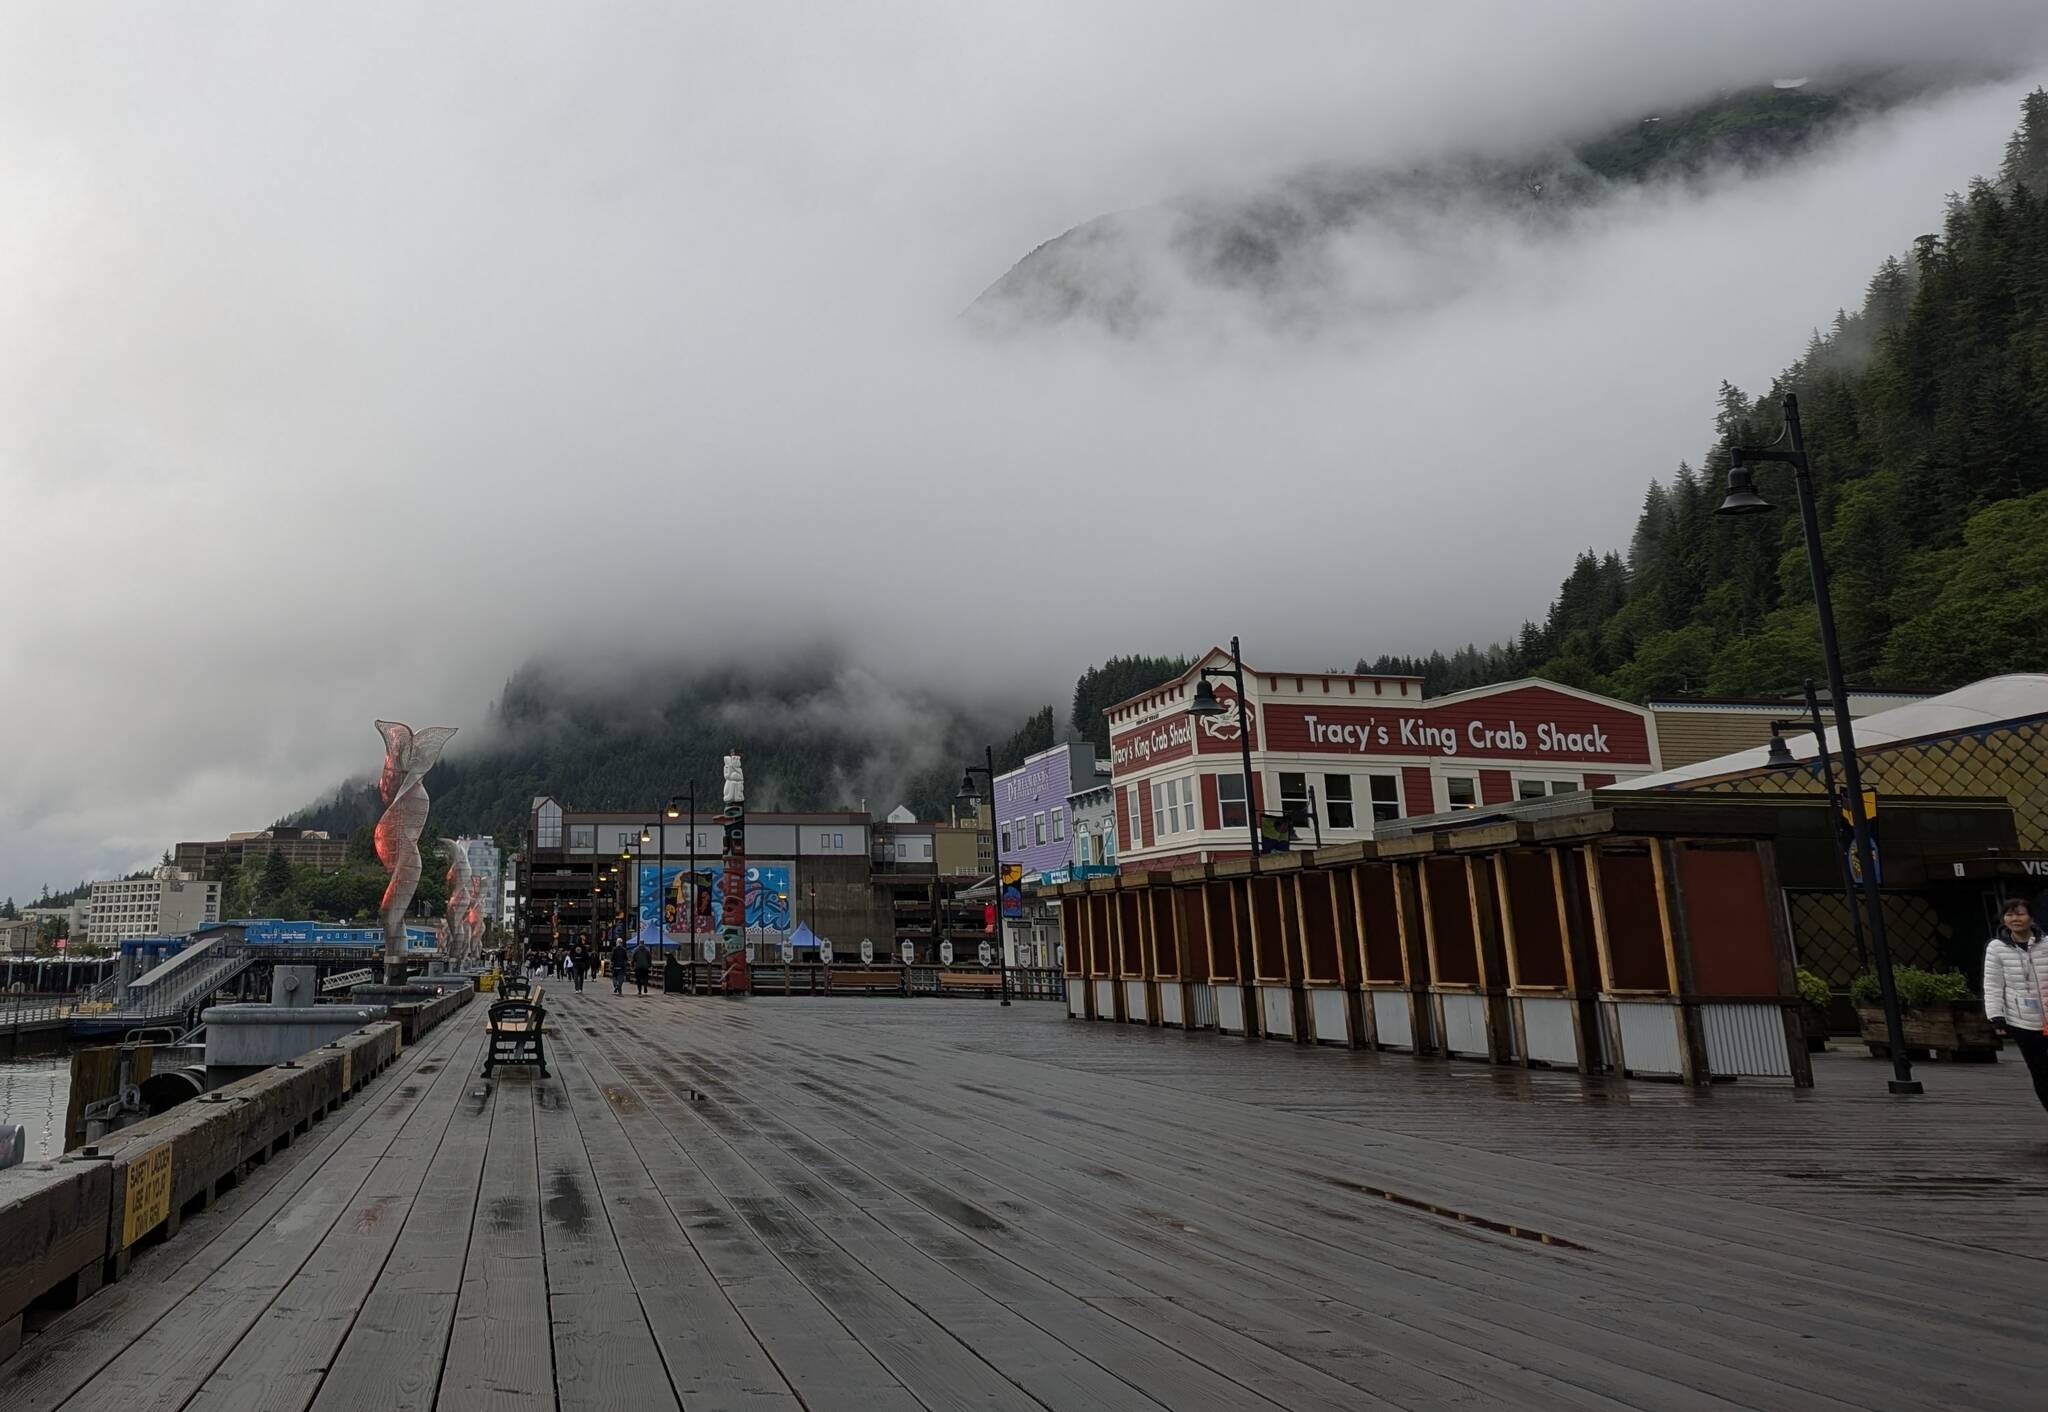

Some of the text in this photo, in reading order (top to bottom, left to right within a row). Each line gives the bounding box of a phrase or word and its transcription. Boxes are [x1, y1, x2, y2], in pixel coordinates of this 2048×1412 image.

[1112, 740, 1133, 767] Tracy's
[1134, 735, 1150, 761] King
[1151, 726, 1168, 753] Crab
[1170, 717, 1192, 746] Shack
[1304, 715, 1610, 755] Tracy's King Crab Shack
[133, 1187, 144, 1213] USE
[144, 1182, 152, 1203] AT
